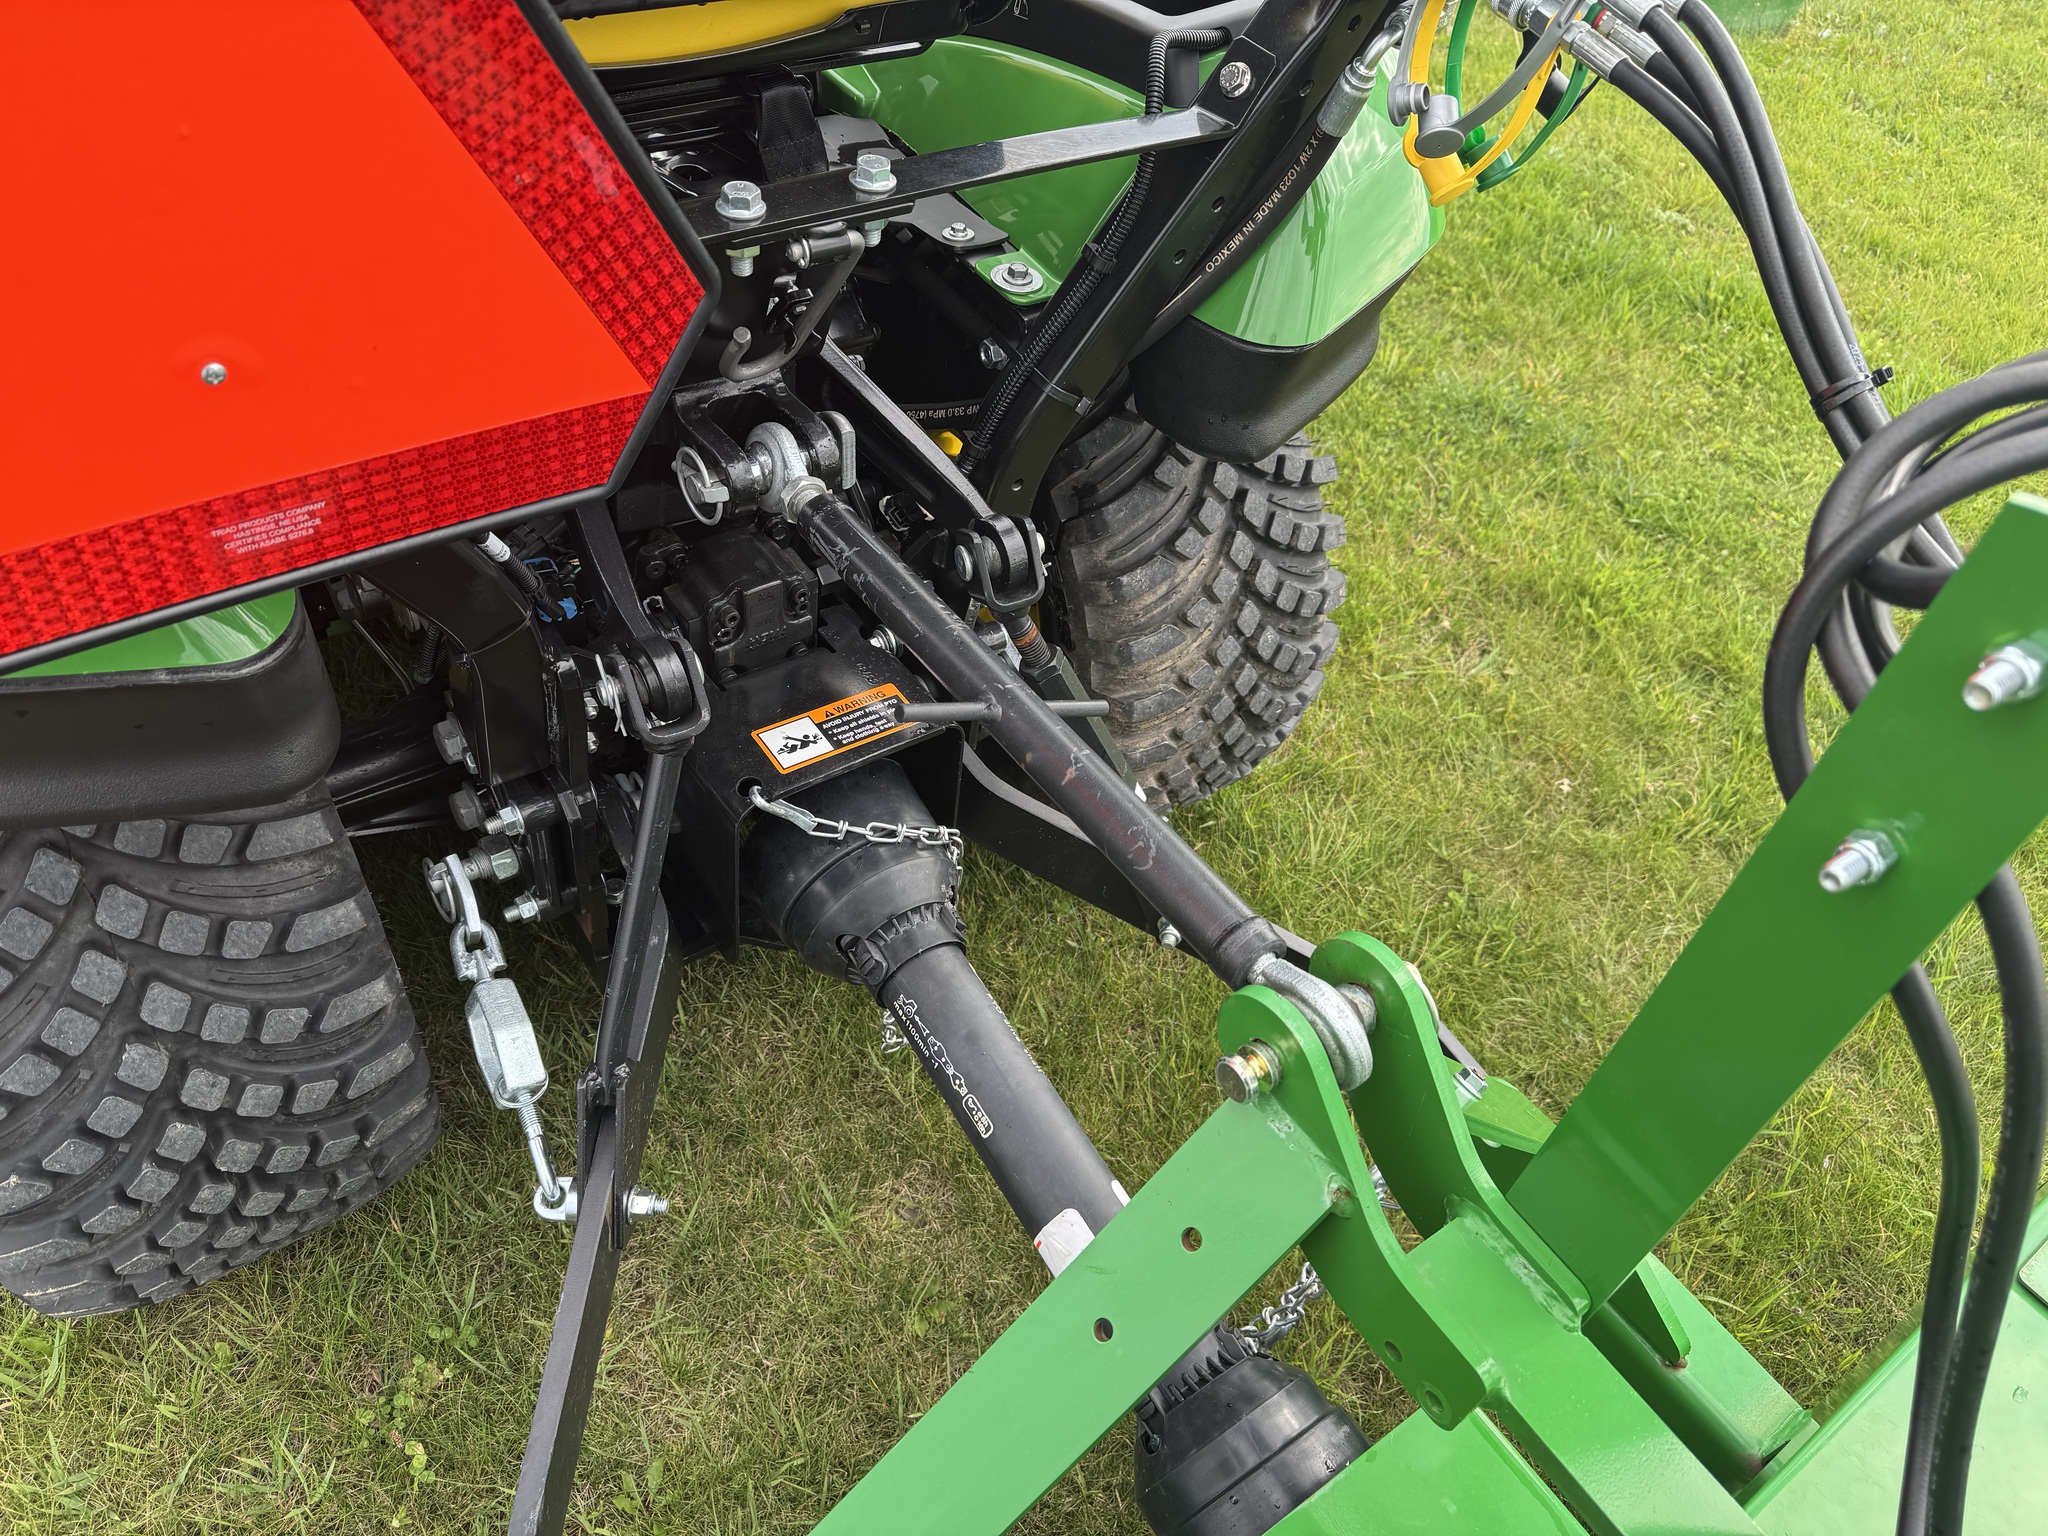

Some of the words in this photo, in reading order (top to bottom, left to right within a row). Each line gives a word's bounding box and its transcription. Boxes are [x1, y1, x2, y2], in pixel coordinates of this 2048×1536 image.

[1310, 135, 1319, 147] X
[1300, 145, 1313, 165] 2W
[1253, 189, 1282, 223] MADE
[1242, 219, 1256, 236] IN
[1205, 232, 1244, 273] MEXICO
[928, 409, 946, 418] MPa
[211, 526, 237, 538] TRIAD
[238, 512, 285, 530] PRODUCTS
[286, 501, 326, 516] COMPANY
[279, 518, 291, 527] NE
[292, 514, 310, 524] USA
[224, 533, 268, 550] CERTIFIES
[268, 518, 322, 538] COMPLIANCE
[236, 544, 259, 554] WITH
[259, 536, 287, 549] ASABE
[833, 691, 886, 713] WARNING
[822, 718, 842, 730] AVOID
[842, 710, 865, 723] INJURY
[865, 704, 884, 713] FROM
[884, 698, 898, 707] PTO
[833, 724, 850, 734] Keep
[857, 714, 880, 726] shields
[838, 730, 855, 740] Keep
[855, 727, 880, 739] clothing
